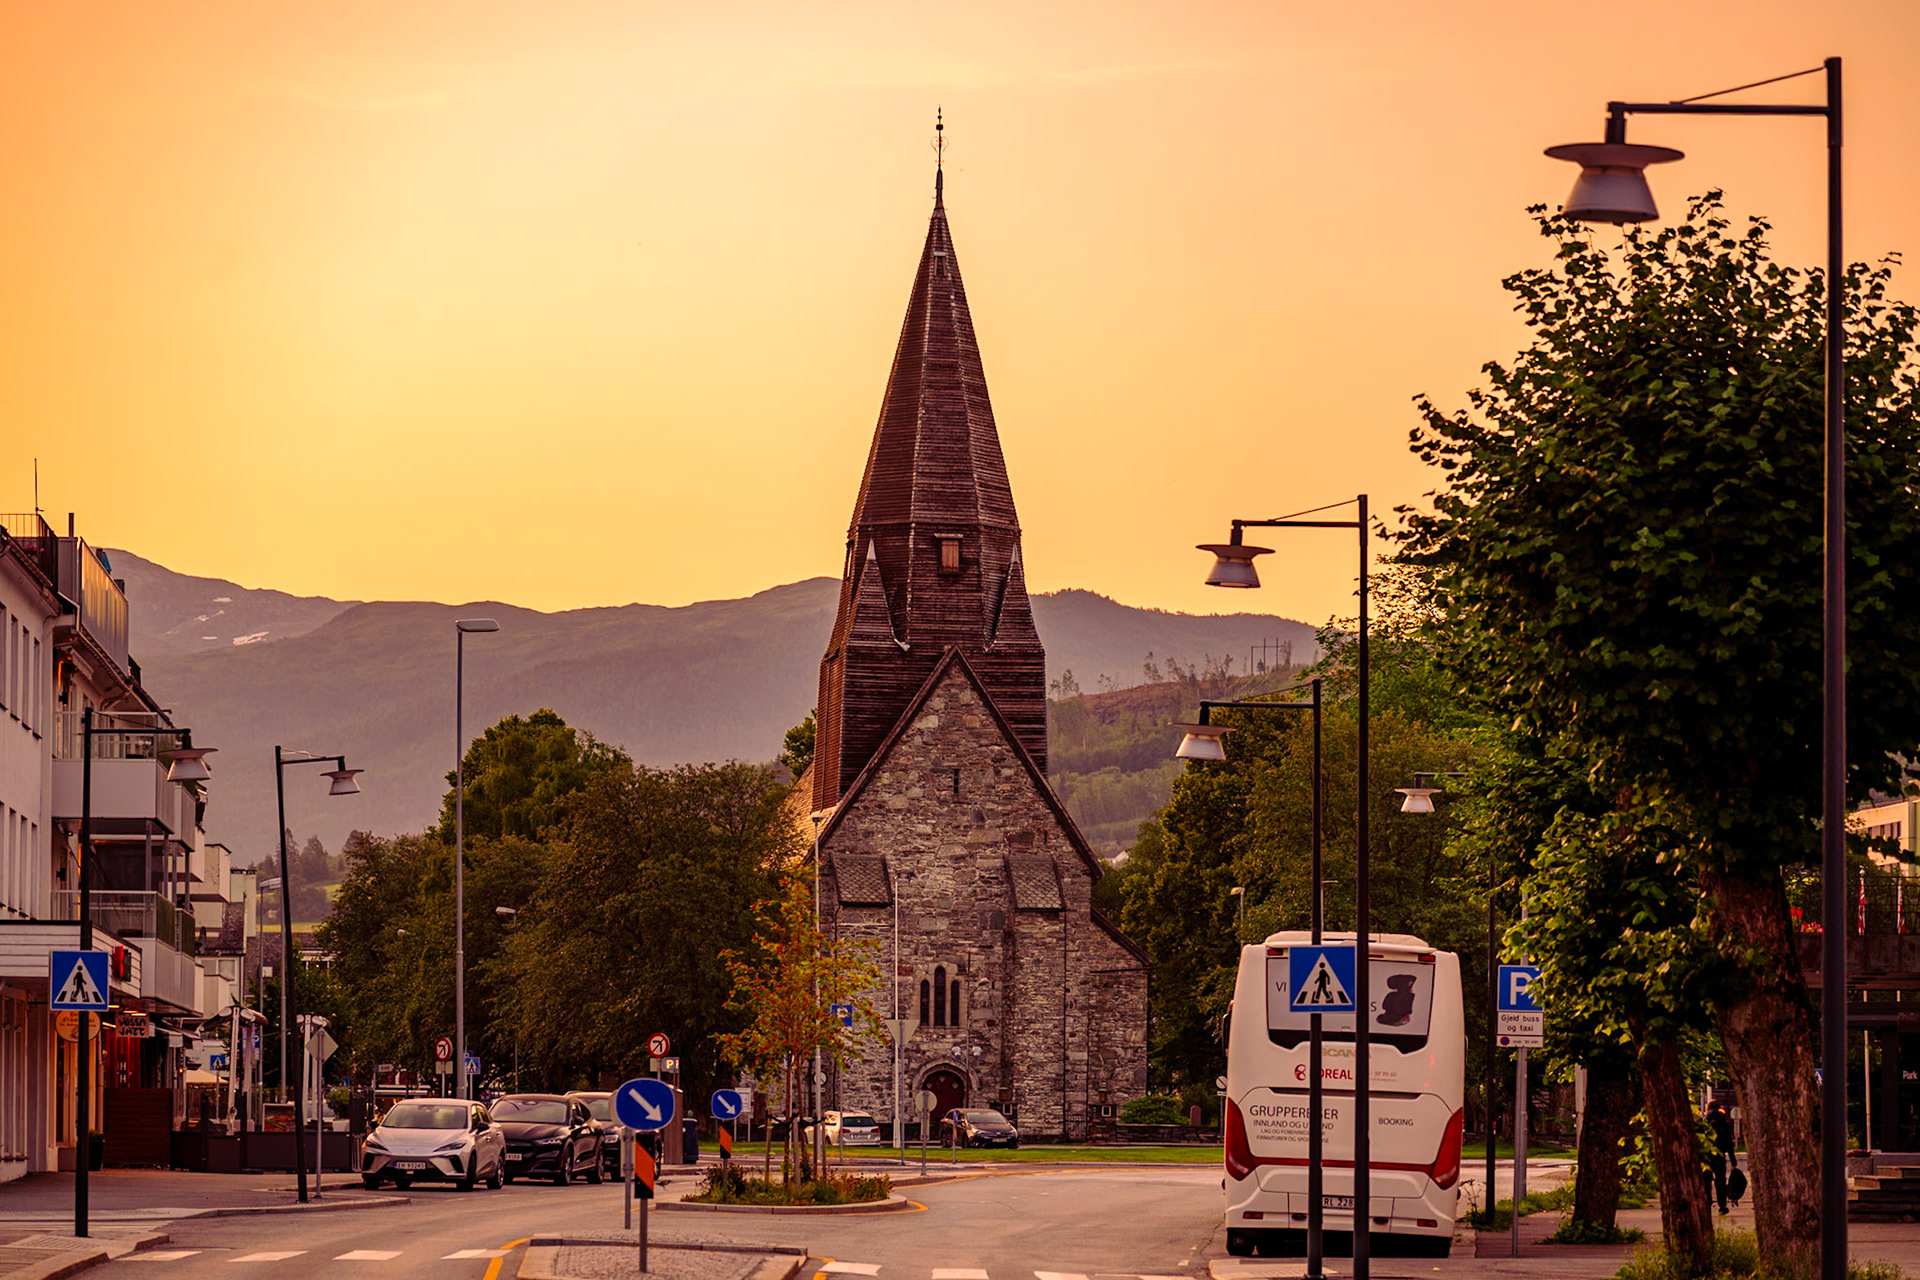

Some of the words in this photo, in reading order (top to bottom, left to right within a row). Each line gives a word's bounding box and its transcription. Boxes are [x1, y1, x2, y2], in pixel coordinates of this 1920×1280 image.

[1276, 982, 1287, 992] VI
[1510, 972, 1533, 1005] P
[1501, 1014, 1520, 1023] Gjeld
[1507, 1025, 1517, 1033] og
[1321, 1048, 1356, 1058] SCAN
[1320, 1068, 1353, 1080] OREAL
[1902, 1070, 1918, 1080] Park
[1249, 1104, 1339, 1120] GRUPPEREER
[1253, 1119, 1288, 1128] INNLAND
[1289, 1121, 1301, 1129] OG
[1302, 1121, 1334, 1131] UND
[1378, 1117, 1414, 1126] BOOKING
